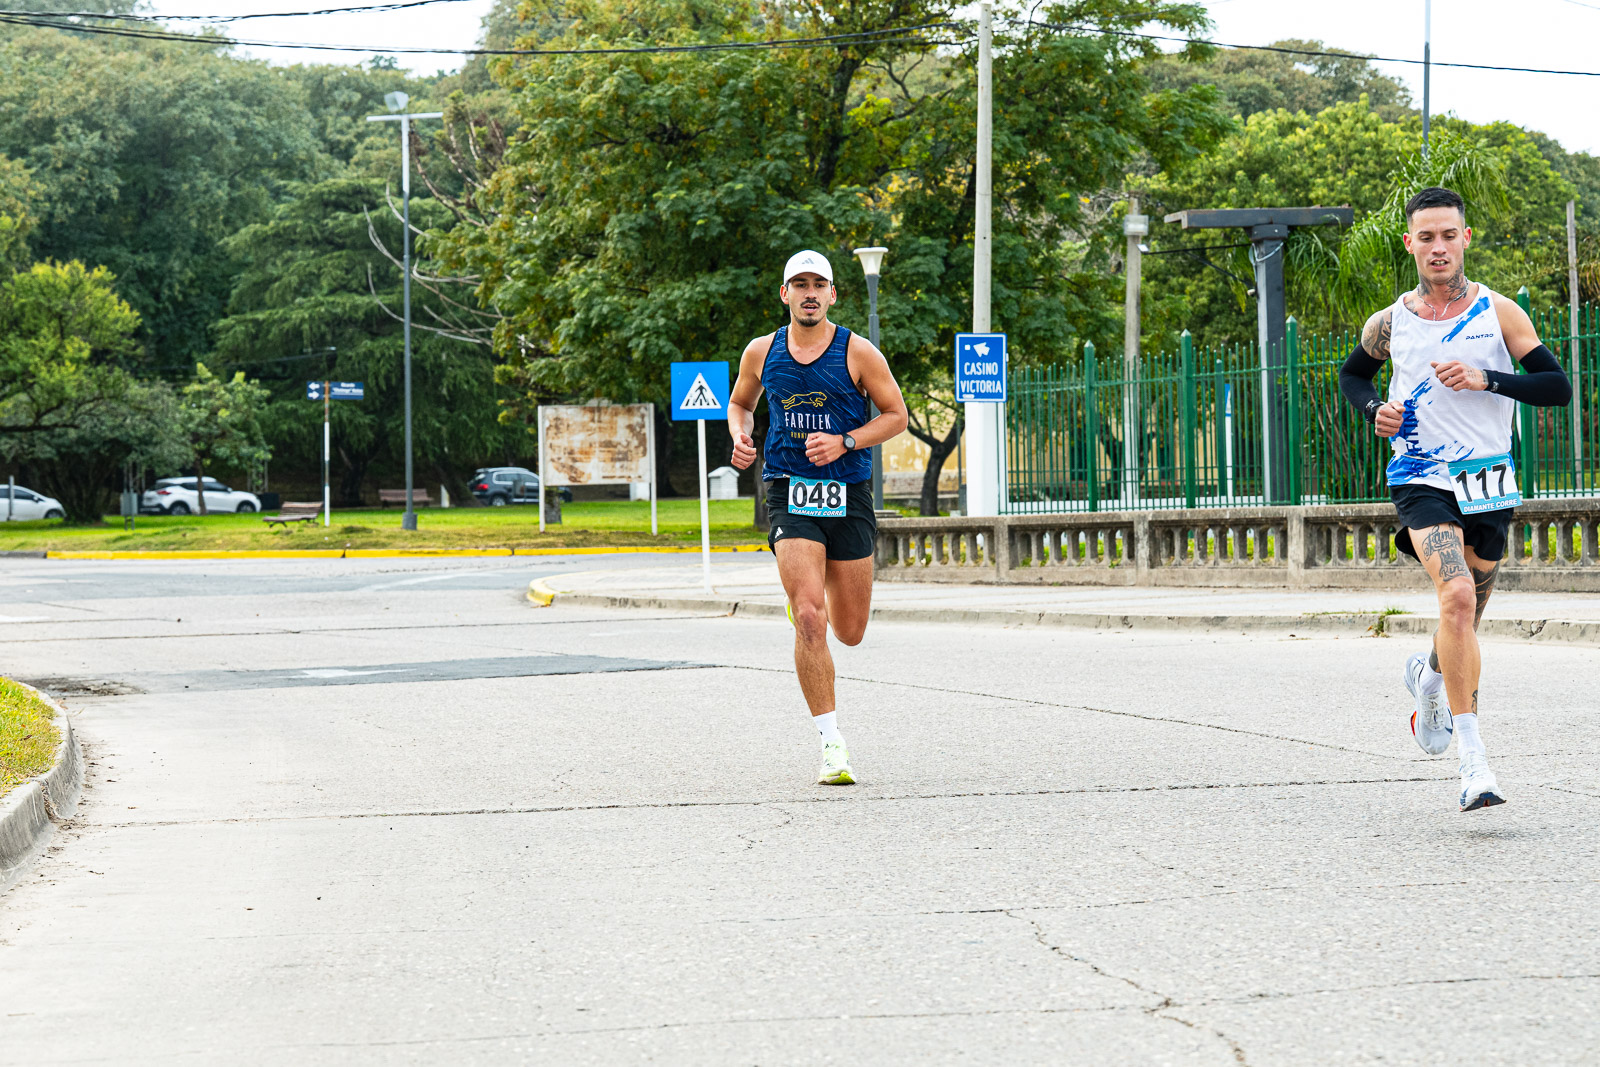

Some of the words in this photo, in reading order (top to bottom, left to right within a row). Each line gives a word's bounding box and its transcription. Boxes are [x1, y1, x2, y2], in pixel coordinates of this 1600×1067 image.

[964, 362, 998, 375] CASINO
[960, 380, 1002, 393] VICTORIA
[784, 411, 831, 430] FARTLEK
[790, 431, 807, 439] RUNNI
[1455, 463, 1507, 503] 117
[792, 481, 842, 509] 048
[1463, 502, 1495, 512] DIAMANTE
[1496, 498, 1518, 508] CORRE
